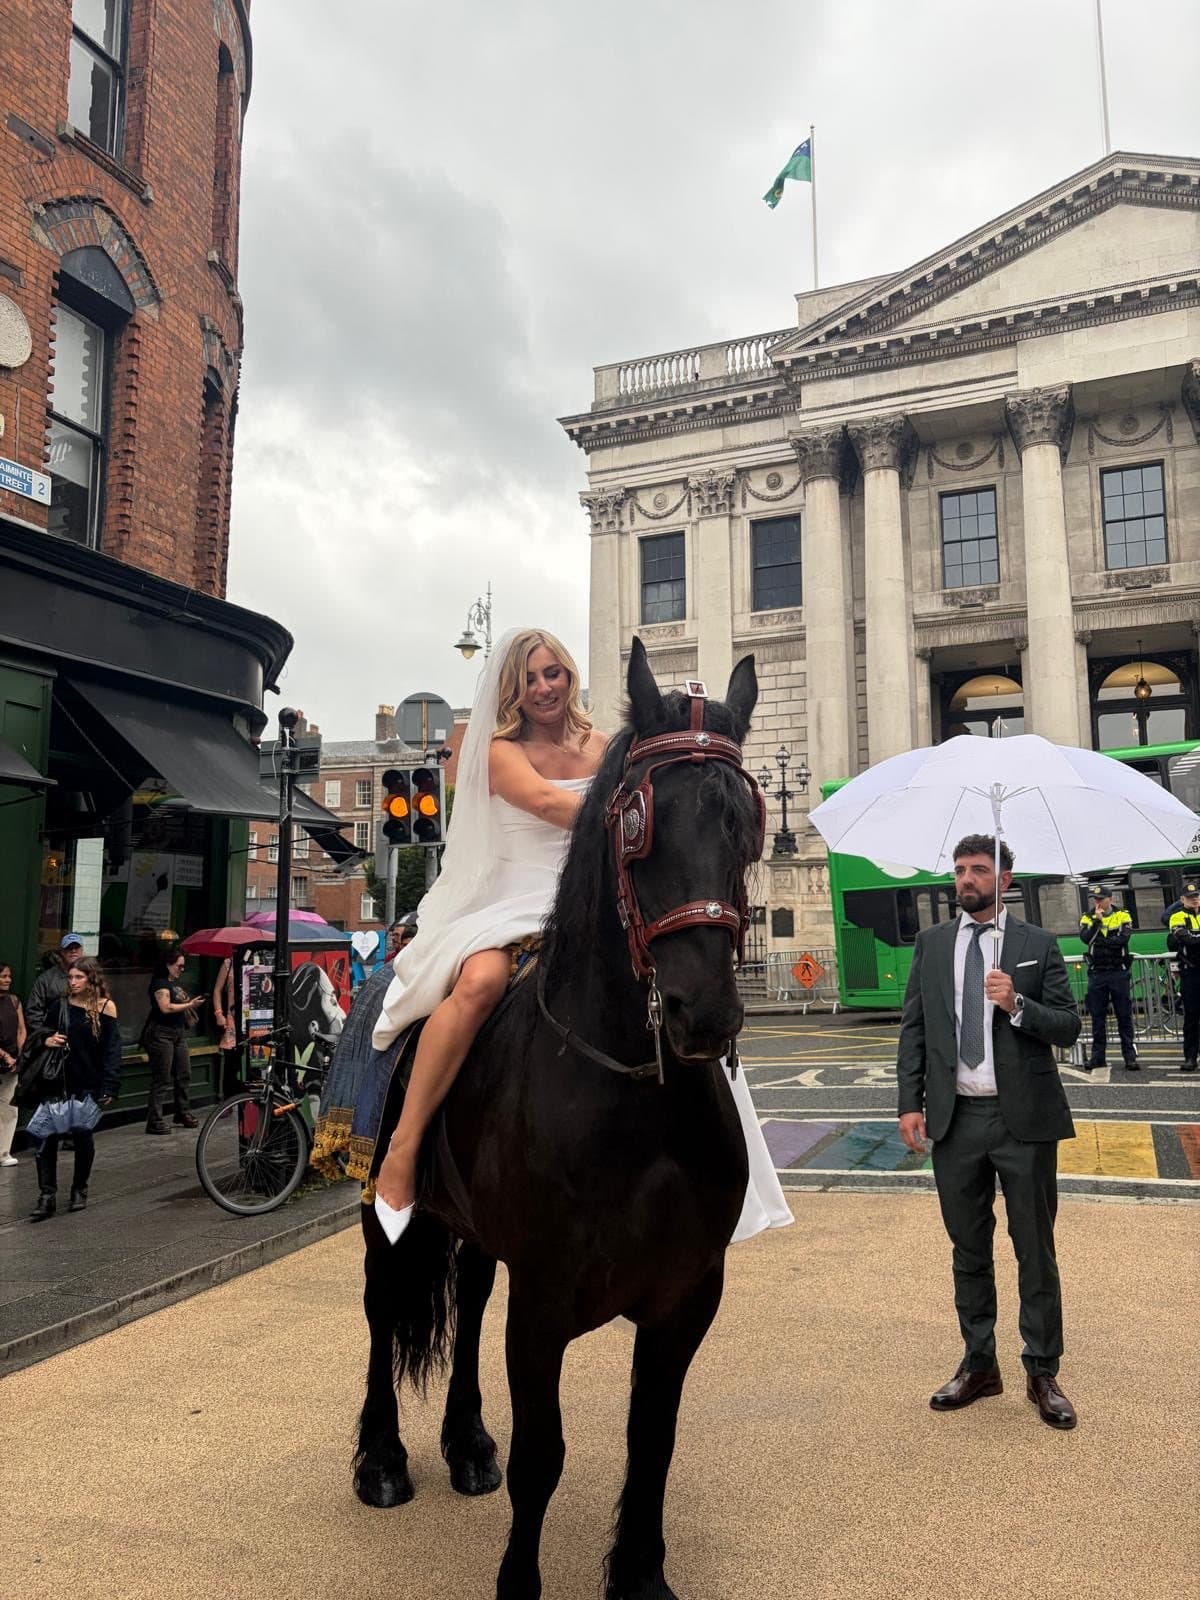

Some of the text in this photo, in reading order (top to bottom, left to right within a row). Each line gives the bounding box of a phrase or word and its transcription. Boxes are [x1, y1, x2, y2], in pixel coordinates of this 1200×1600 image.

[0, 462, 32, 482] AIMINTE
[0, 474, 28, 491] TREET
[38, 482, 45, 496] 2
